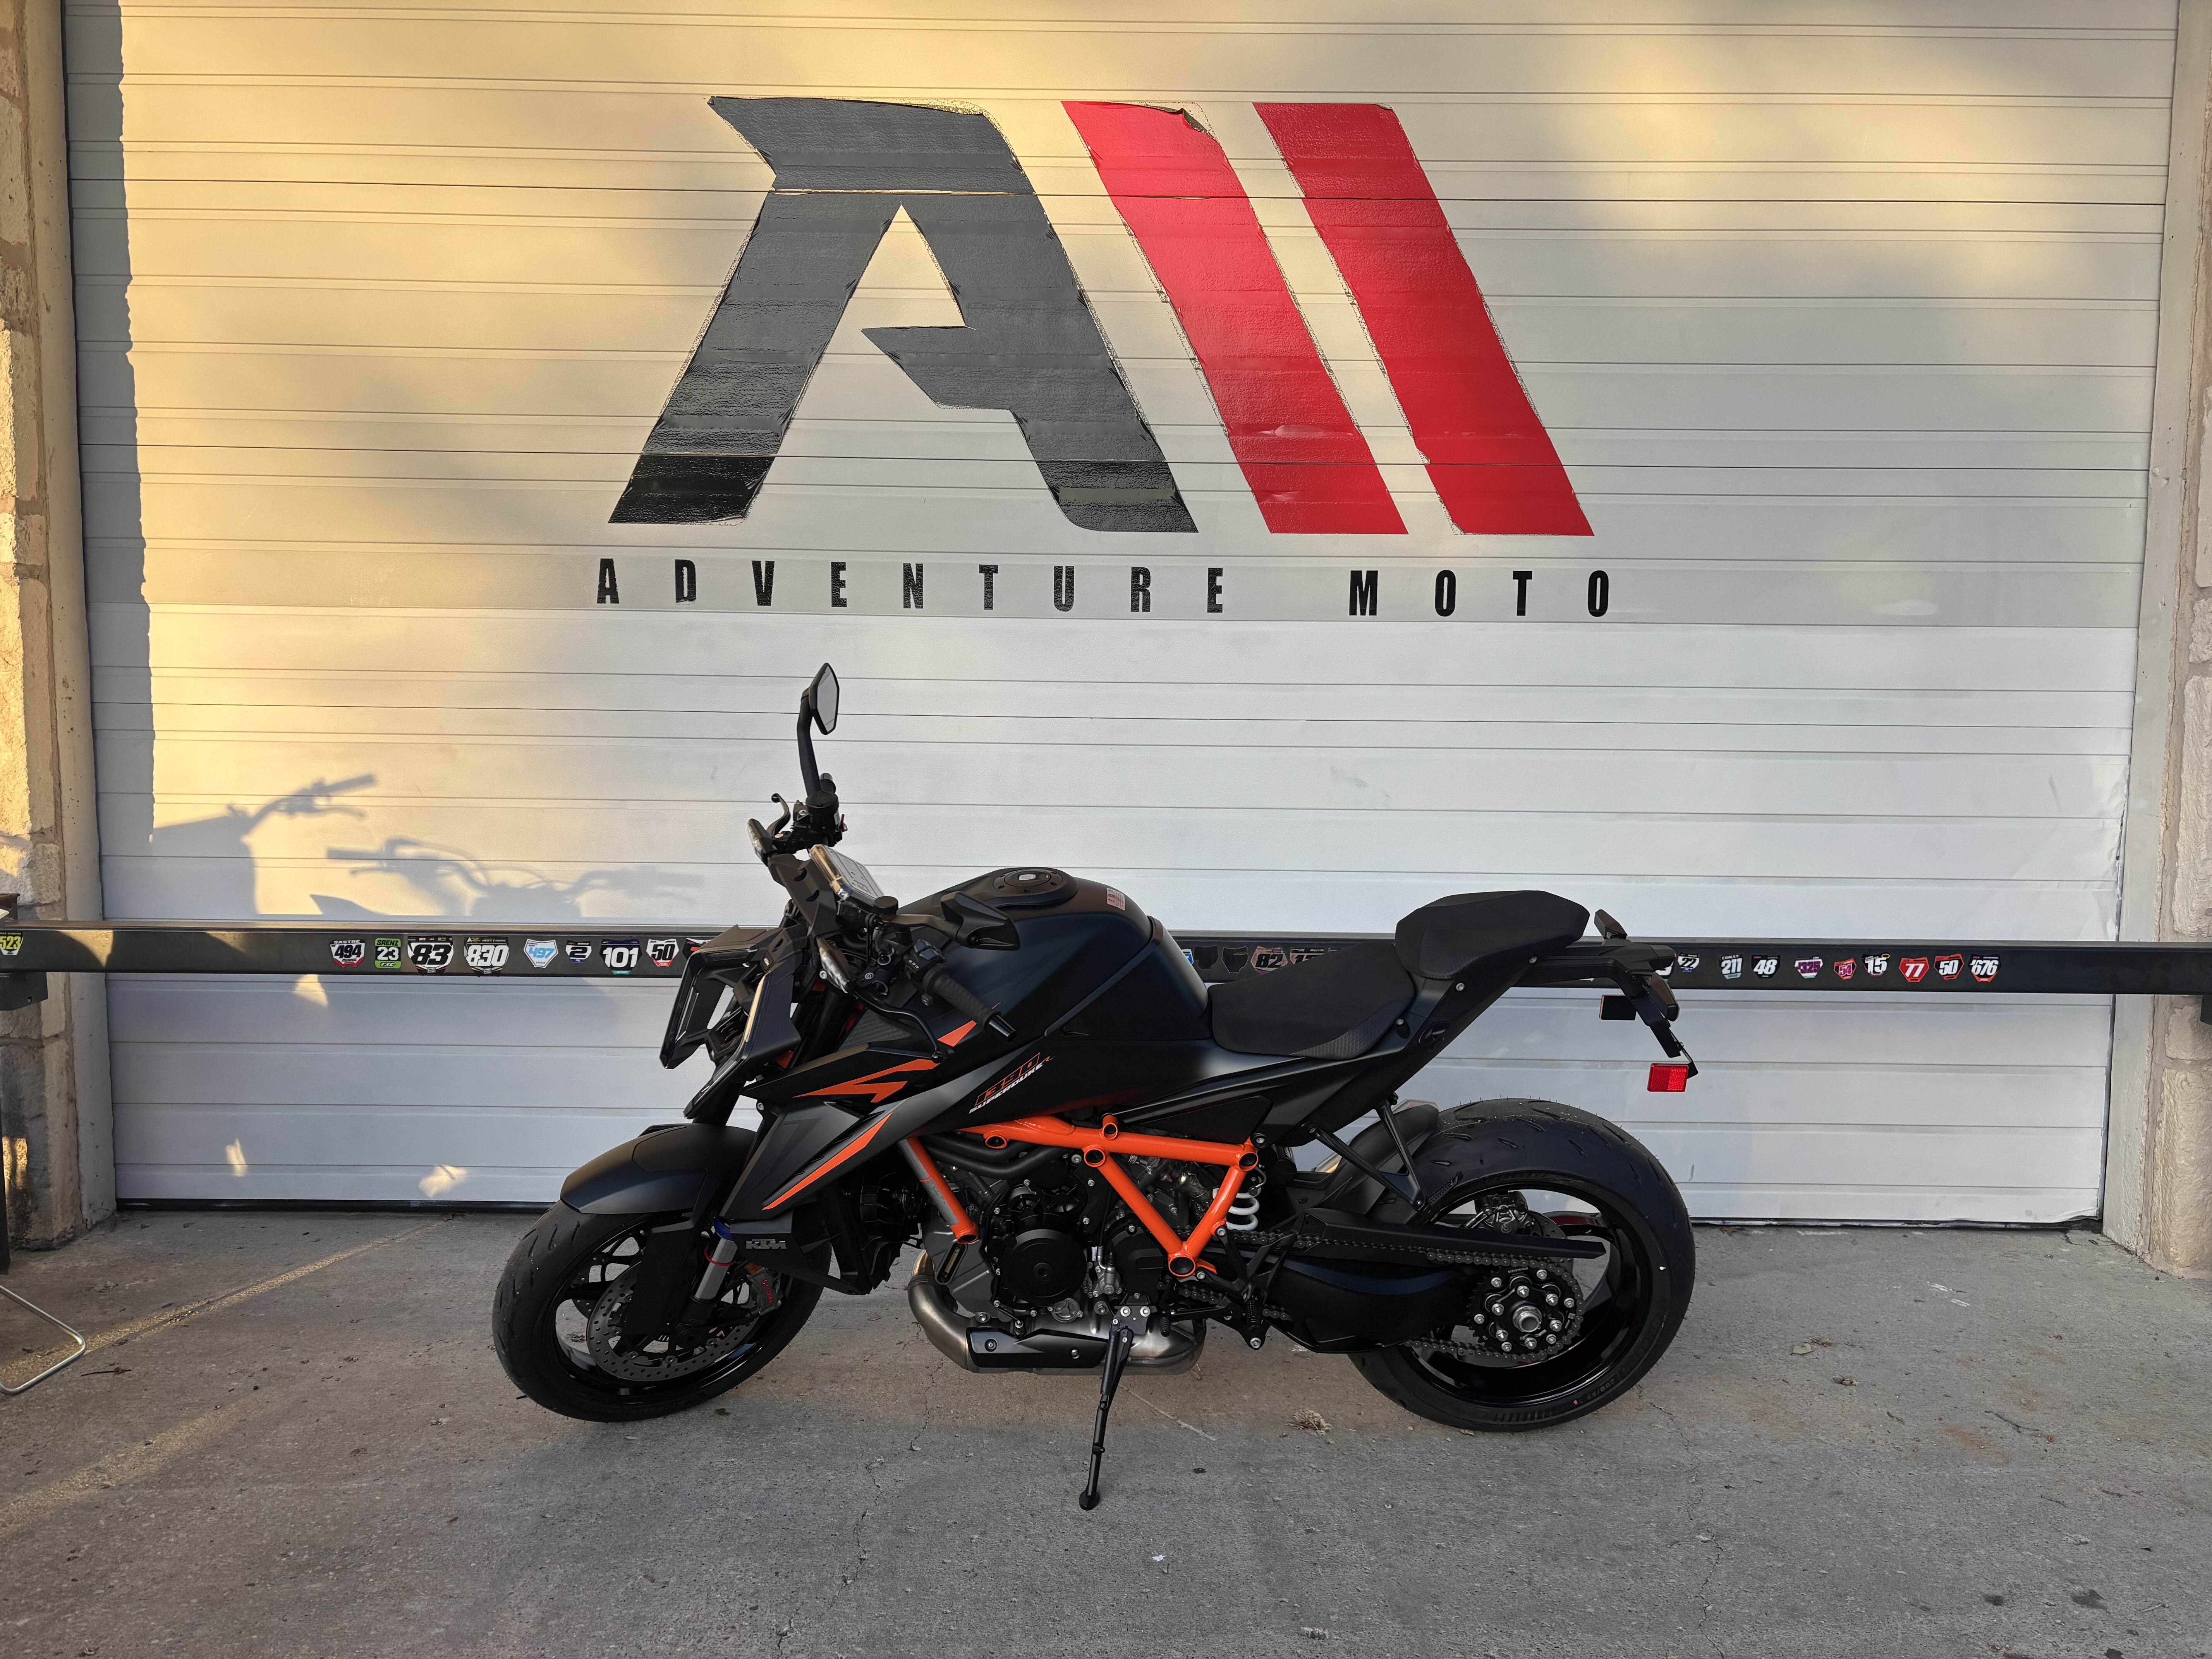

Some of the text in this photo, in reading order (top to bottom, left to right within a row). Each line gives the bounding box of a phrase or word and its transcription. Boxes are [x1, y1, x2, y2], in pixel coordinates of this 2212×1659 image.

[596, 558, 1609, 618] ADVENTURE MOTO
[335, 945, 362, 958] 494
[377, 947, 399, 960] 23
[411, 944, 452, 965] 83
[465, 945, 509, 966] 830
[528, 947, 555, 958] 497
[569, 946, 588, 958] 2
[603, 947, 639, 967] 101
[651, 944, 675, 961] 50
[1255, 954, 1283, 968] 82
[1681, 958, 1697, 968] 22
[1721, 958, 1742, 974] 211
[1753, 959, 1778, 975] 48
[1865, 957, 1887, 975] 15
[1939, 960, 1959, 975] 50
[1905, 963, 1925, 977] 77
[746, 1239, 787, 1249] KTM
